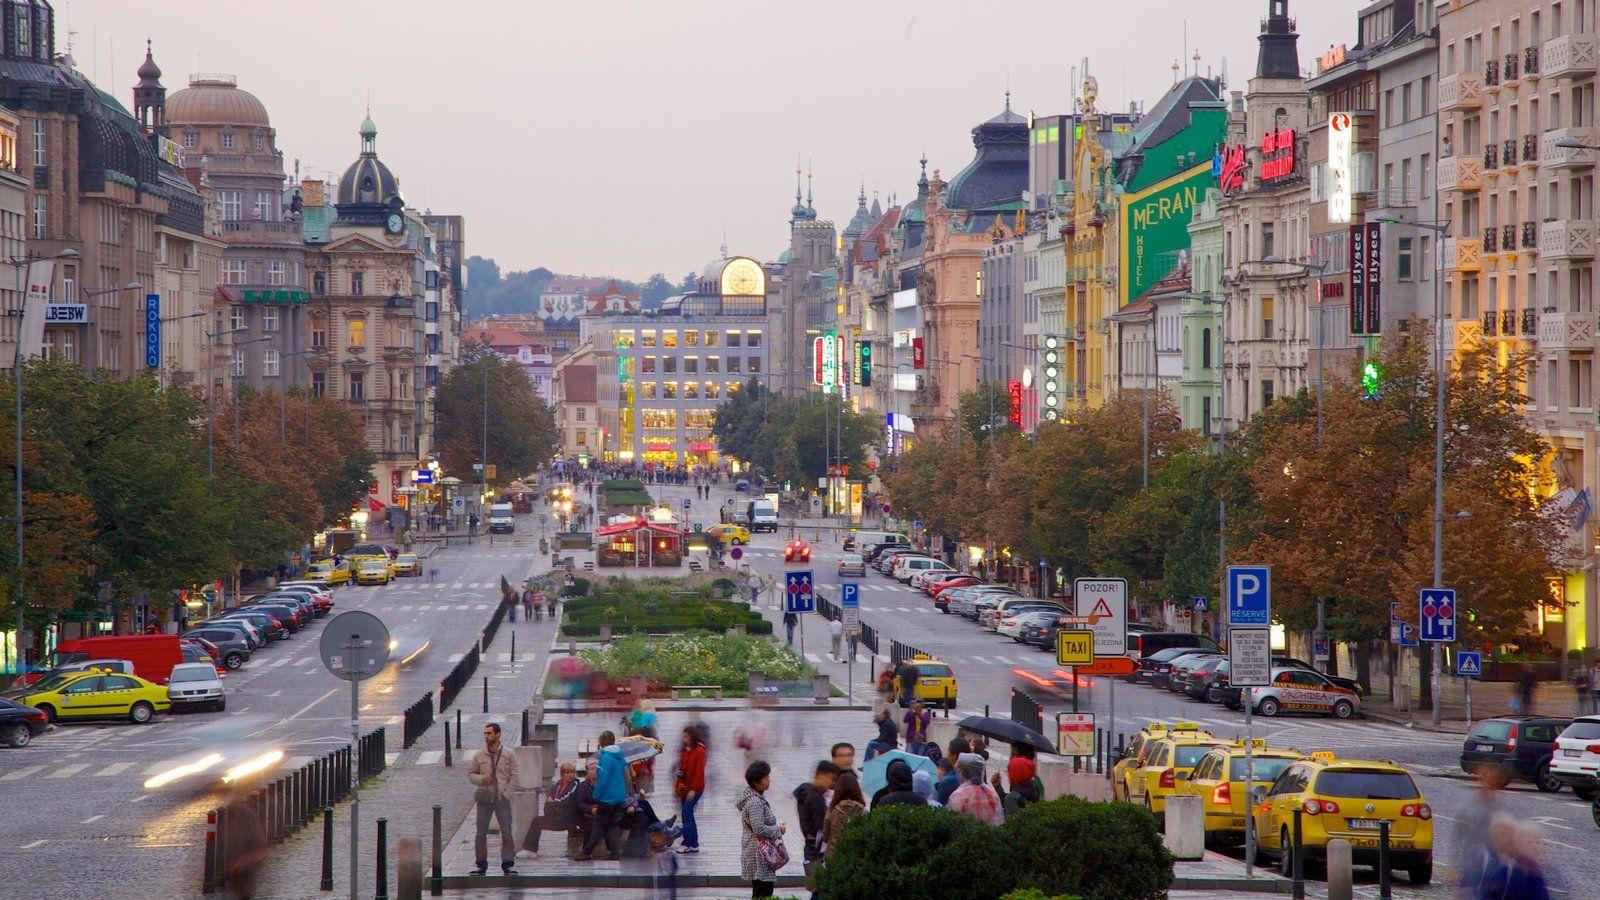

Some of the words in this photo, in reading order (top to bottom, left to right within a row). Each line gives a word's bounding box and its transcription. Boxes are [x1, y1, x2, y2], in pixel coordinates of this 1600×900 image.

[1133, 186, 1197, 230] MERAN
[1136, 235, 1144, 286] HOTEL
[1353, 231, 1363, 284] Elysee
[1370, 229, 1380, 283] Elysee
[148, 299, 157, 366] ROKOKO
[845, 586, 856, 600] P
[1237, 574, 1260, 607] P
[1065, 641, 1087, 654] TAXI
